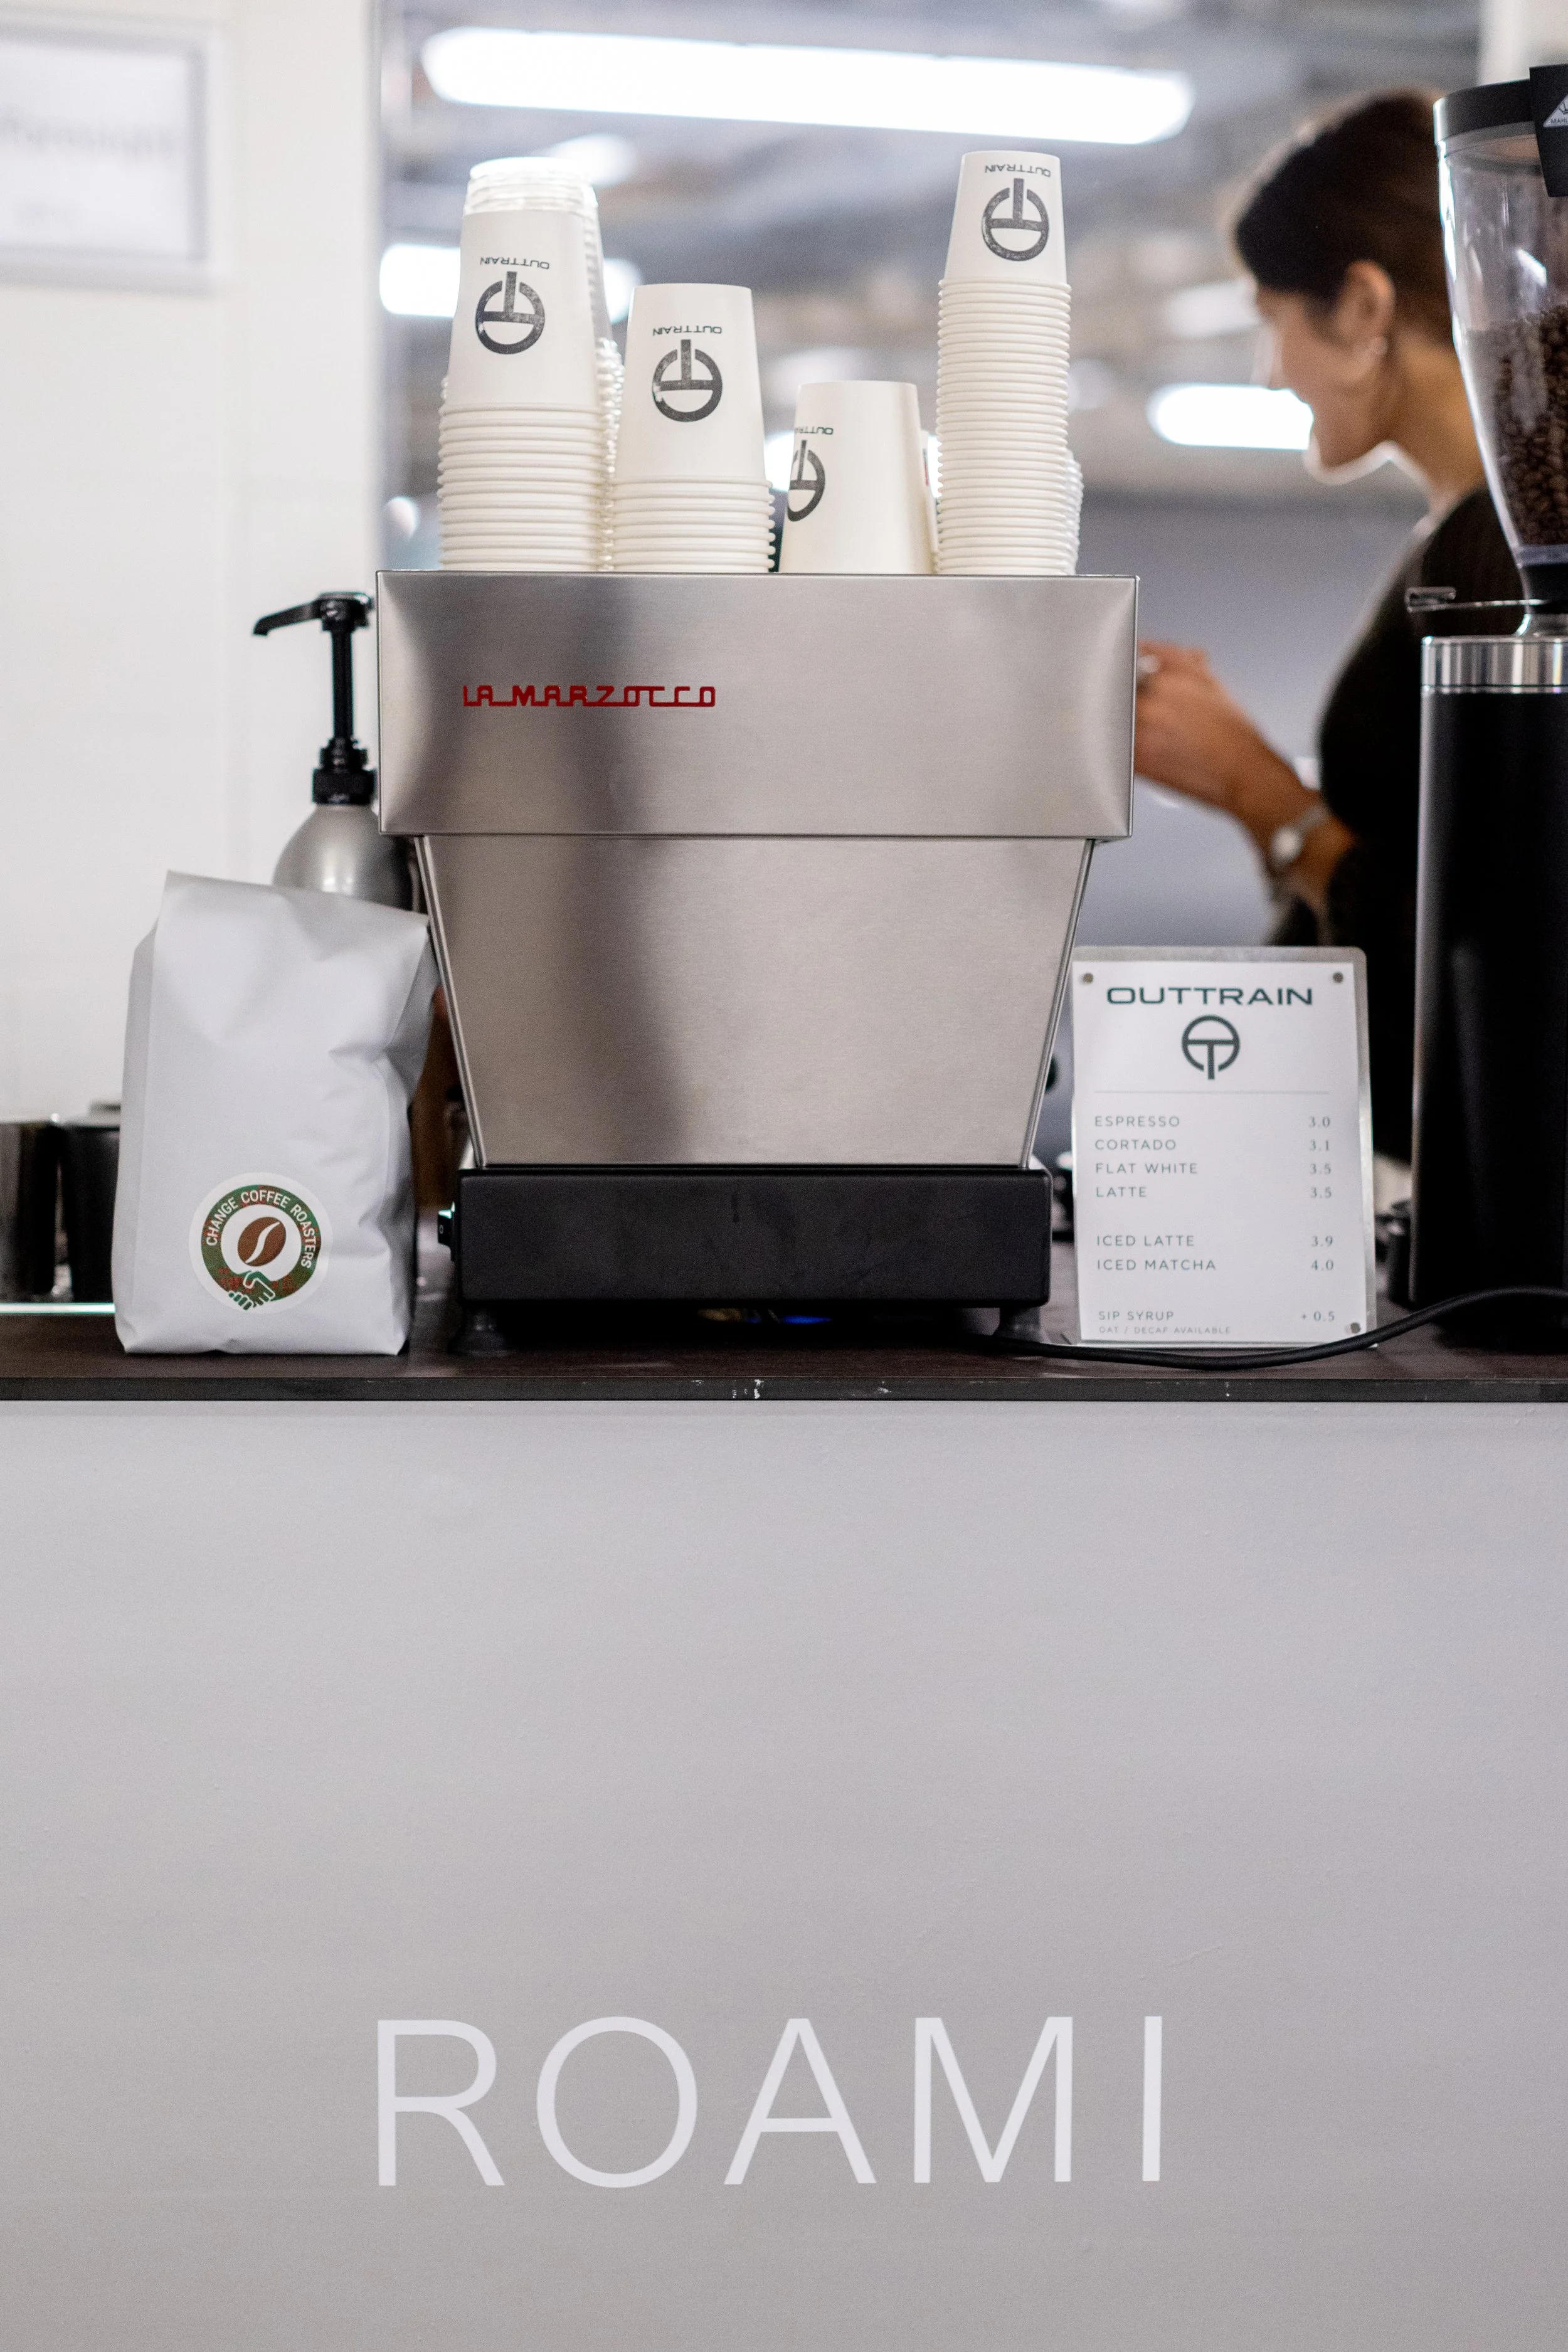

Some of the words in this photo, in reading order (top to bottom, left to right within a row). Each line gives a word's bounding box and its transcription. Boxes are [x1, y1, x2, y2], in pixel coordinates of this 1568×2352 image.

[985, 164, 1051, 177] OUTTRAIN
[480, 257, 550, 270] OUTTRAIN
[653, 325, 722, 336] OUTTRAIN
[1106, 986, 1313, 1007] OUTTRAIN
[1094, 1116, 1180, 1127] ESPRESSO
[1310, 1116, 1331, 1128] 3.0
[1094, 1139, 1176, 1150] CORTADO
[1310, 1140, 1330, 1151] 3.1
[1096, 1163, 1136, 1174] FLAT
[1145, 1163, 1197, 1174] WHITE
[1311, 1163, 1332, 1175] 3.5
[1096, 1186, 1147, 1198] LATTE
[1311, 1187, 1332, 1199] 3.5
[206, 1197, 238, 1246] CHANGE
[241, 1189, 290, 1208] COFFEE
[290, 1204, 317, 1269] ROASTERS
[1097, 1235, 1136, 1247] ICED
[1144, 1235, 1194, 1247] LATTE
[1311, 1236, 1333, 1248] 3.9
[1097, 1259, 1136, 1271] ICED
[1145, 1259, 1216, 1271] MATCHA
[1311, 1259, 1334, 1271] 4.0
[1098, 1310, 1120, 1321] SIP
[1127, 1310, 1174, 1322] SYRUP
[1313, 1311, 1335, 1322] 0.5
[1134, 1326, 1168, 1334] DECAF
[1174, 1326, 1231, 1335] AVAILABLE
[377, 2016, 1163, 2188] ROAMI
